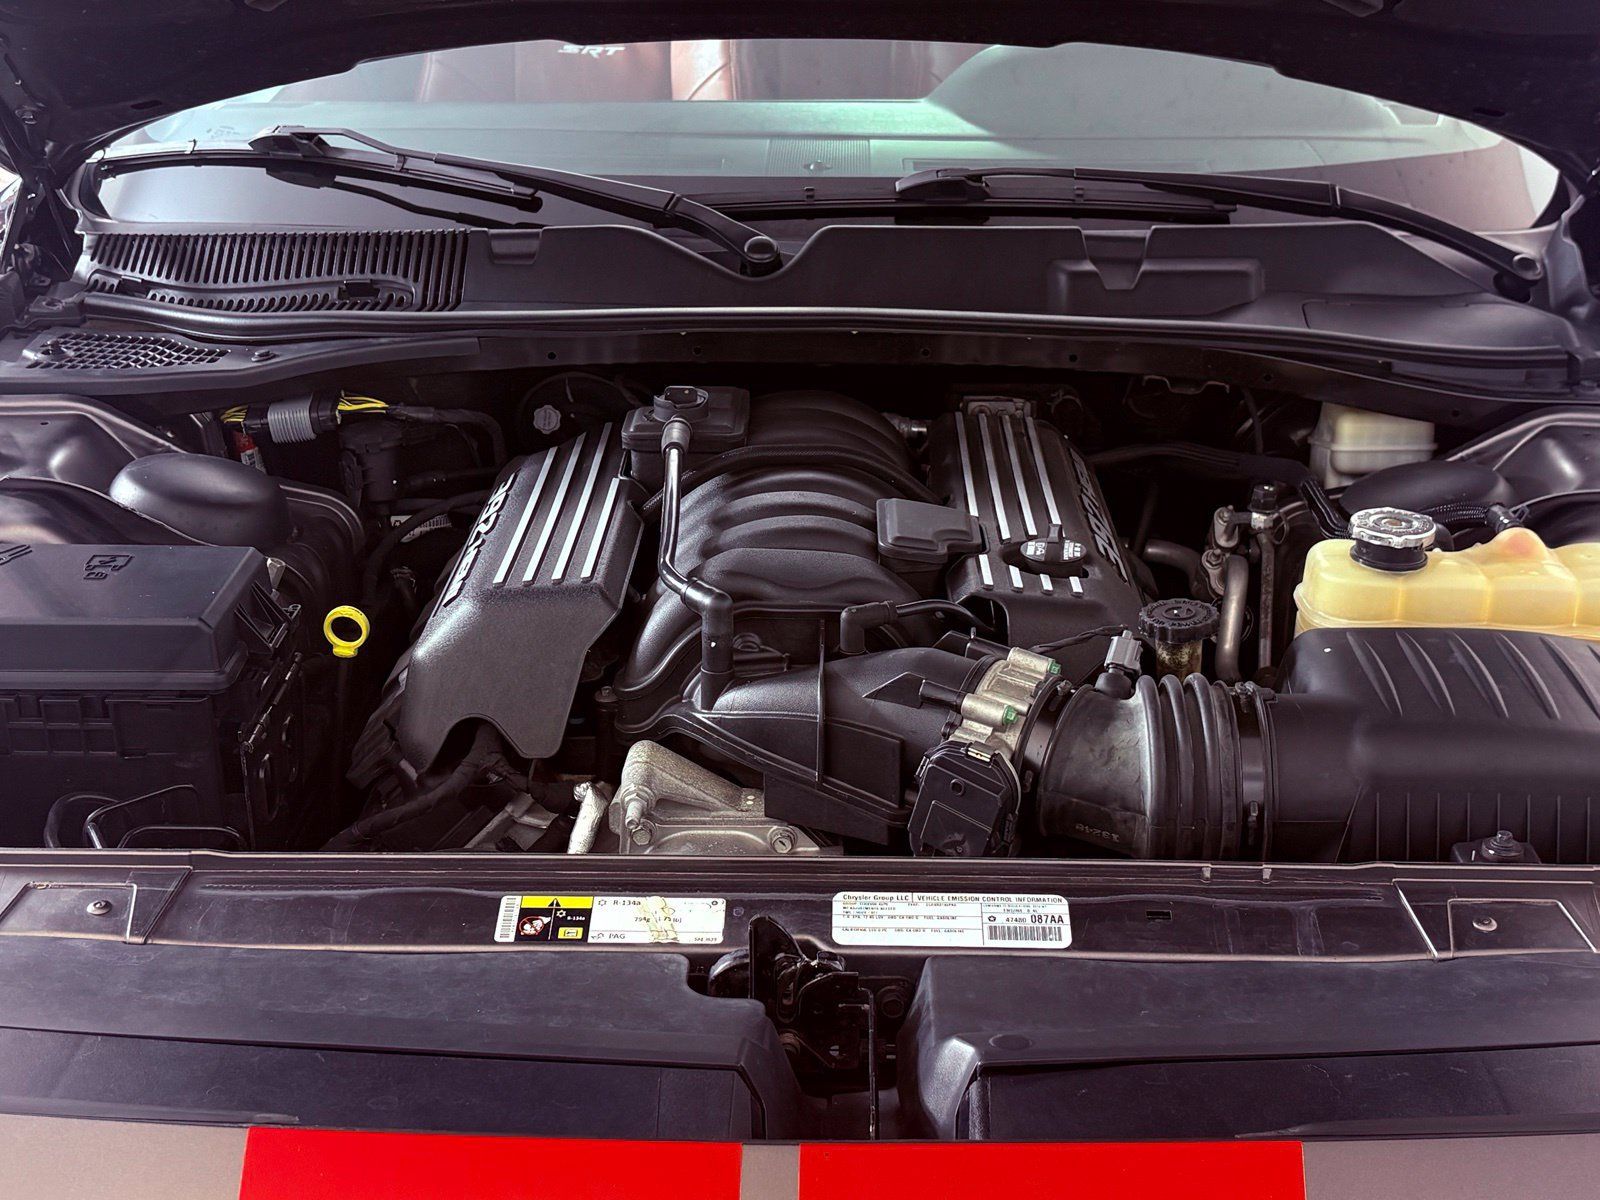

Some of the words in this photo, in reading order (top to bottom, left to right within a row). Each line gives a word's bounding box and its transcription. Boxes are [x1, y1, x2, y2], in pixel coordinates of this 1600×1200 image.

[558, 44, 625, 59] SRT
[842, 894, 871, 902] Chrysler
[1030, 914, 1064, 924] 087AA
